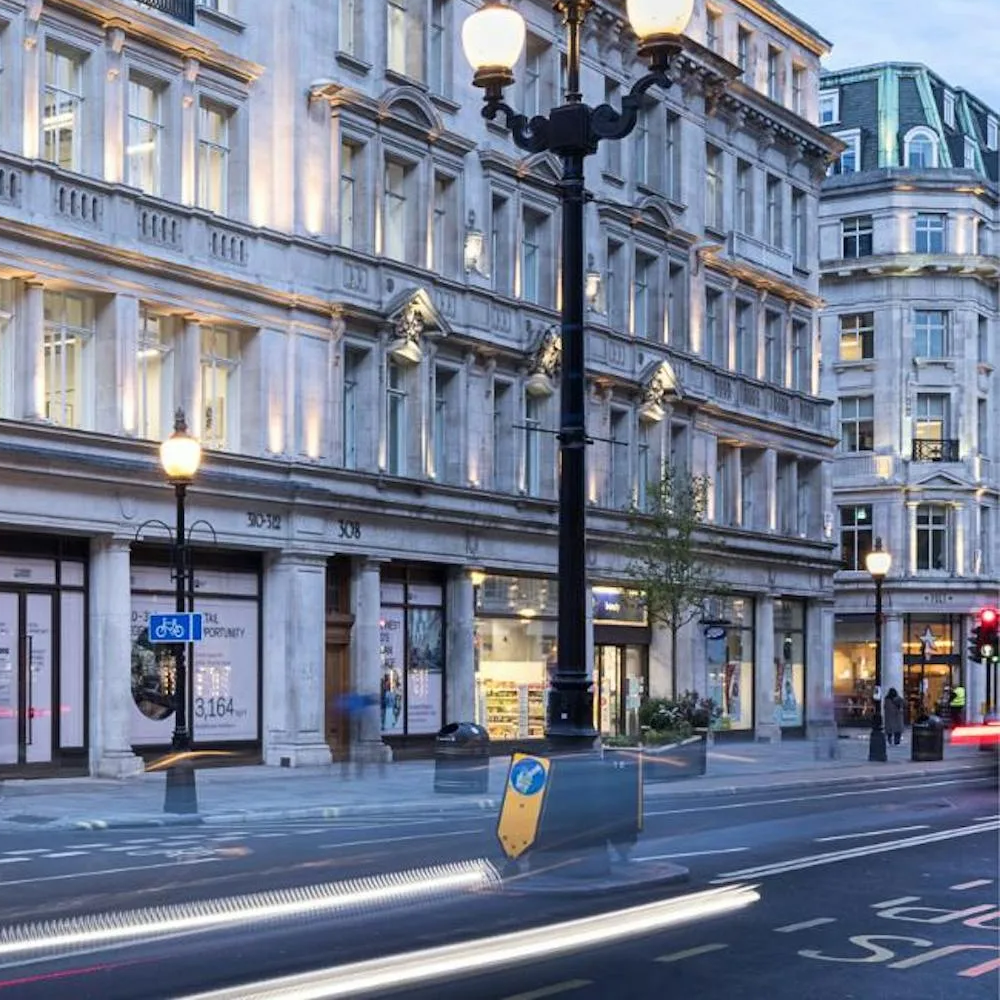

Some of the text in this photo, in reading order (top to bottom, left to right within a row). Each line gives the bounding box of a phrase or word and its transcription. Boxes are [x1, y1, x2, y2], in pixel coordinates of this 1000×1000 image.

[338, 519, 361, 539] 308
[203, 626, 246, 638] PORTUNITY
[194, 696, 234, 721] 3,164
